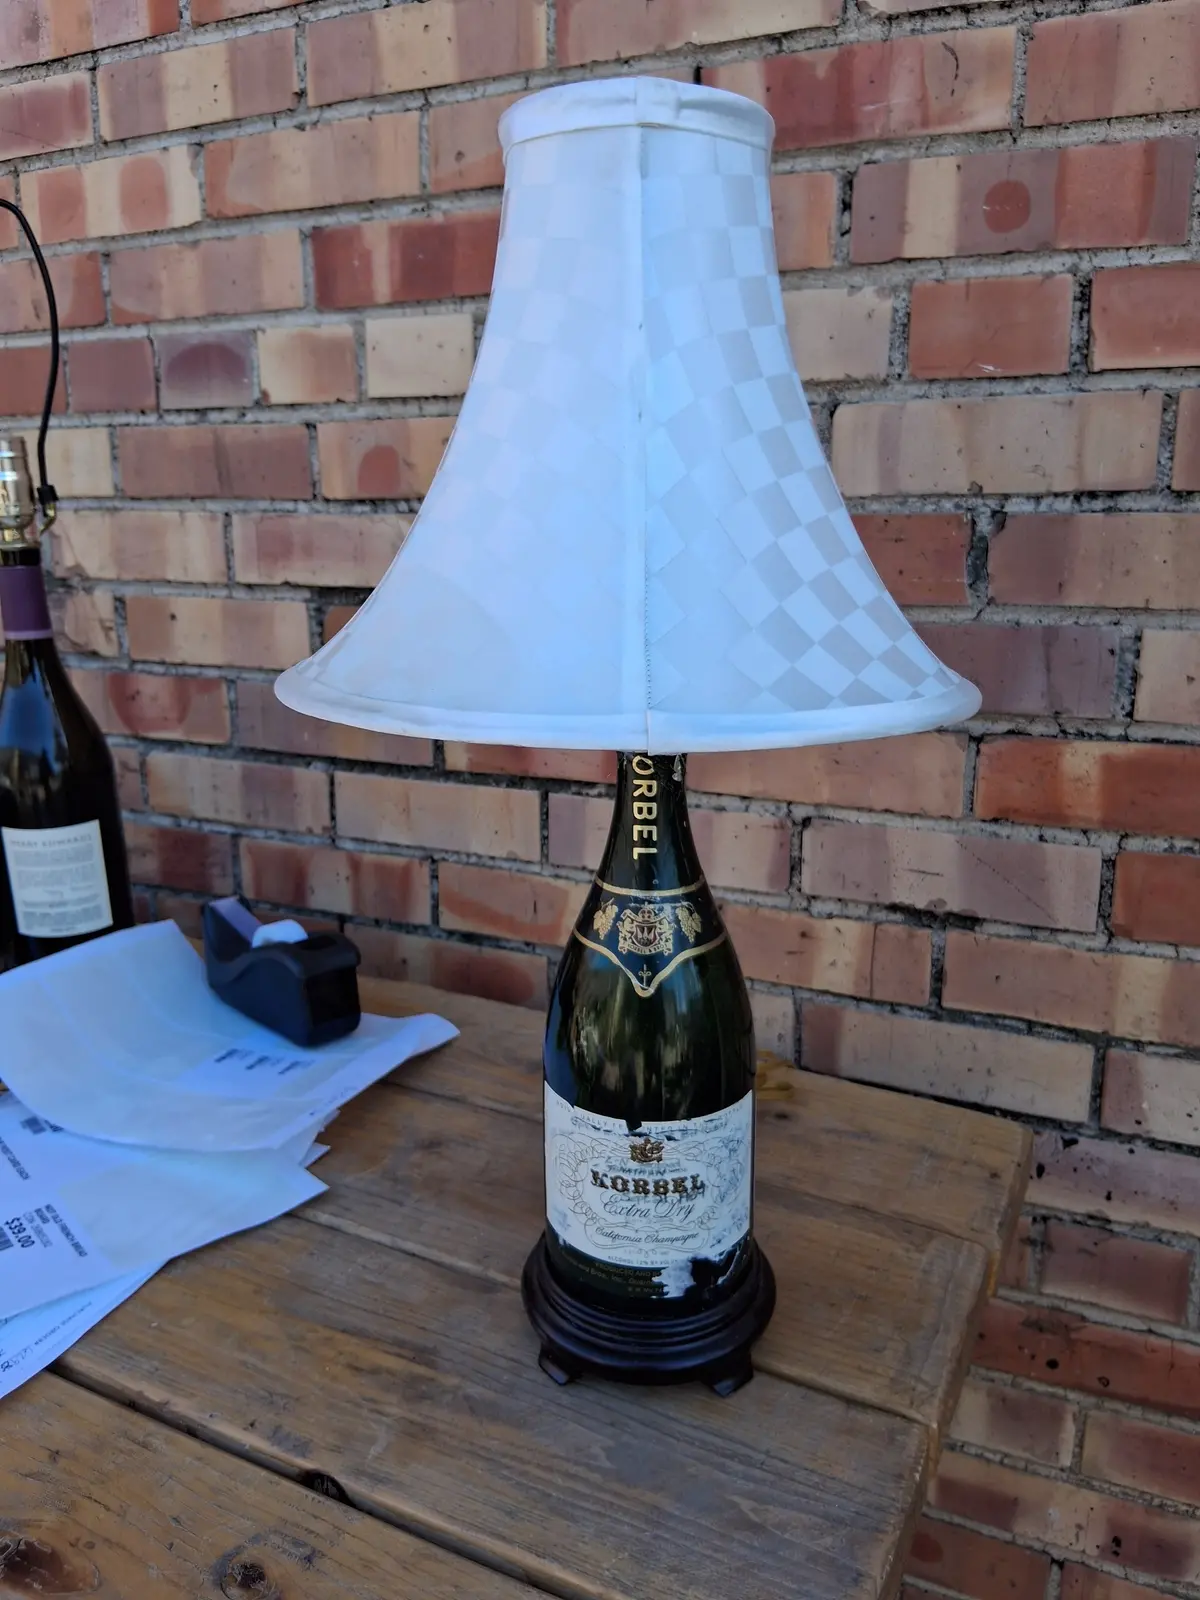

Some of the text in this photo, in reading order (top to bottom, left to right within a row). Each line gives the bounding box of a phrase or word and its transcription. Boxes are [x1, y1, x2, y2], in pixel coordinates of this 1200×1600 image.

[590, 1168, 705, 1195] KORBEL
[603, 1193, 696, 1223] Extra Dry
[4, 1217, 35, 1248] $39.00
[595, 1226, 700, 1245] California Champagne
